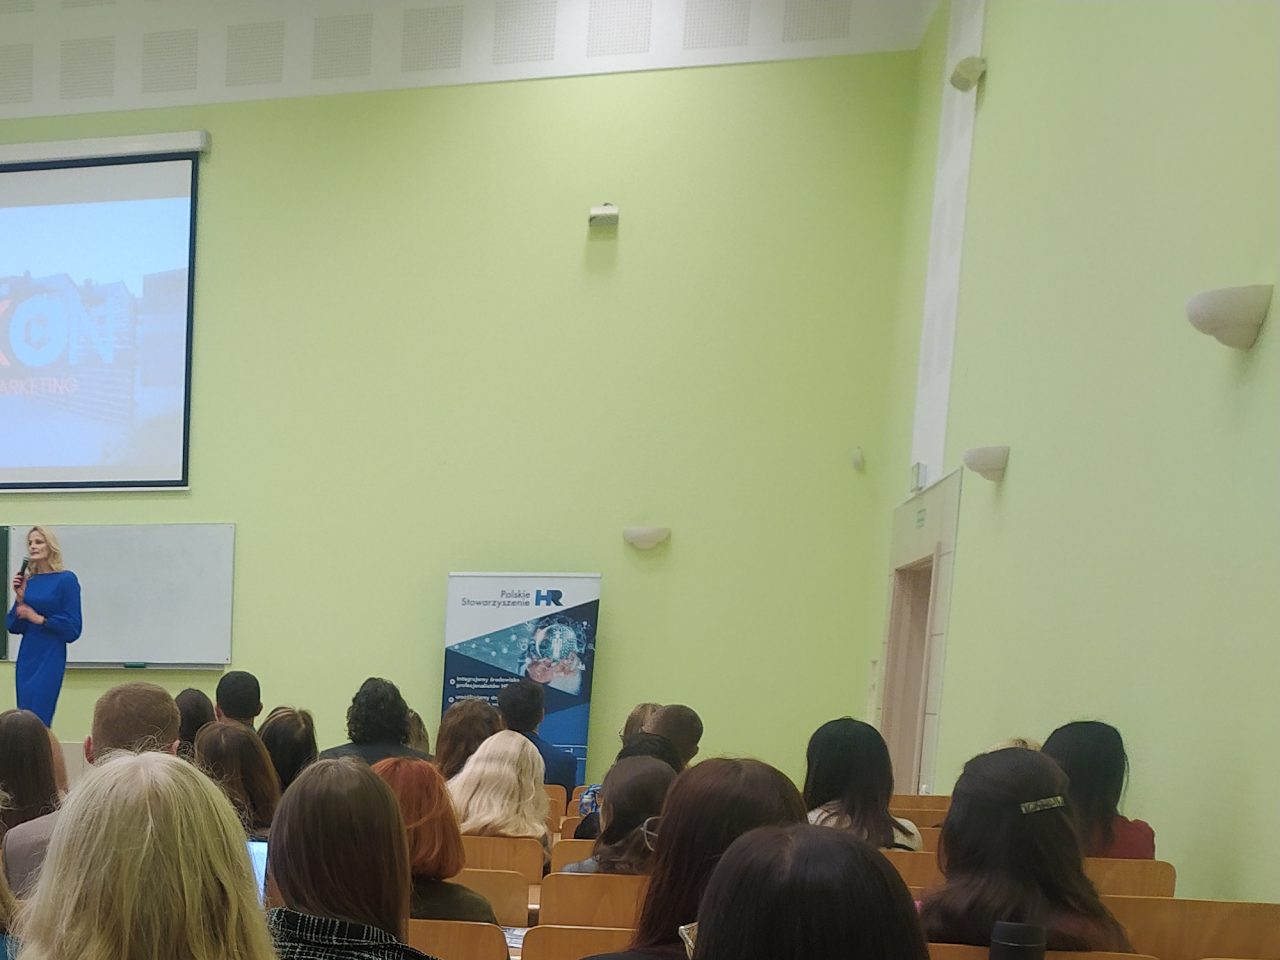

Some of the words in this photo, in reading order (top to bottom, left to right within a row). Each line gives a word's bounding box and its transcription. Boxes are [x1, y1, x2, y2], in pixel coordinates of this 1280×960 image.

[500, 590, 530, 599] Polskie
[534, 589, 564, 607] HR
[461, 598, 530, 608] Stowarzyszenie
